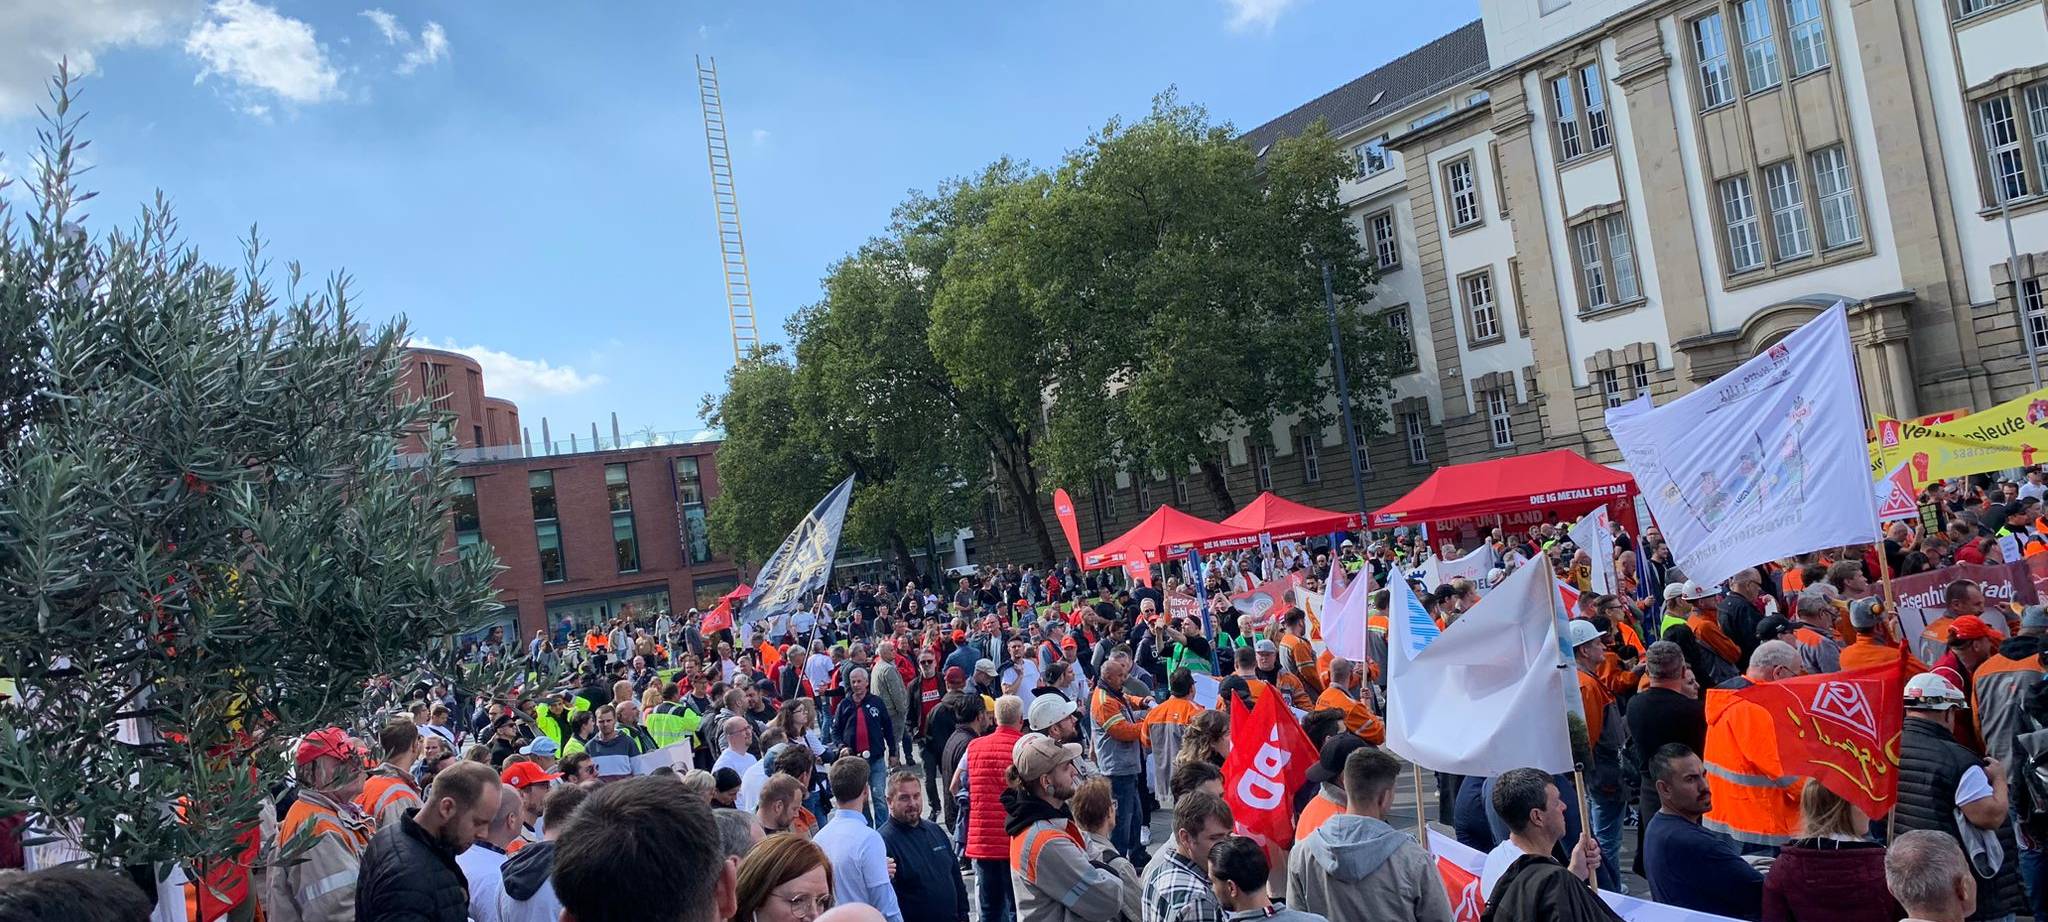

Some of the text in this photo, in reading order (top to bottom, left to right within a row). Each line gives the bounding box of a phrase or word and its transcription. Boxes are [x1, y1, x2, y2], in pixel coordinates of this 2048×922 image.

[1530, 483, 1627, 505] DIE IG METALL IST DA!
[1505, 509, 1543, 525] LAND
[1220, 538, 1239, 547] METALL
